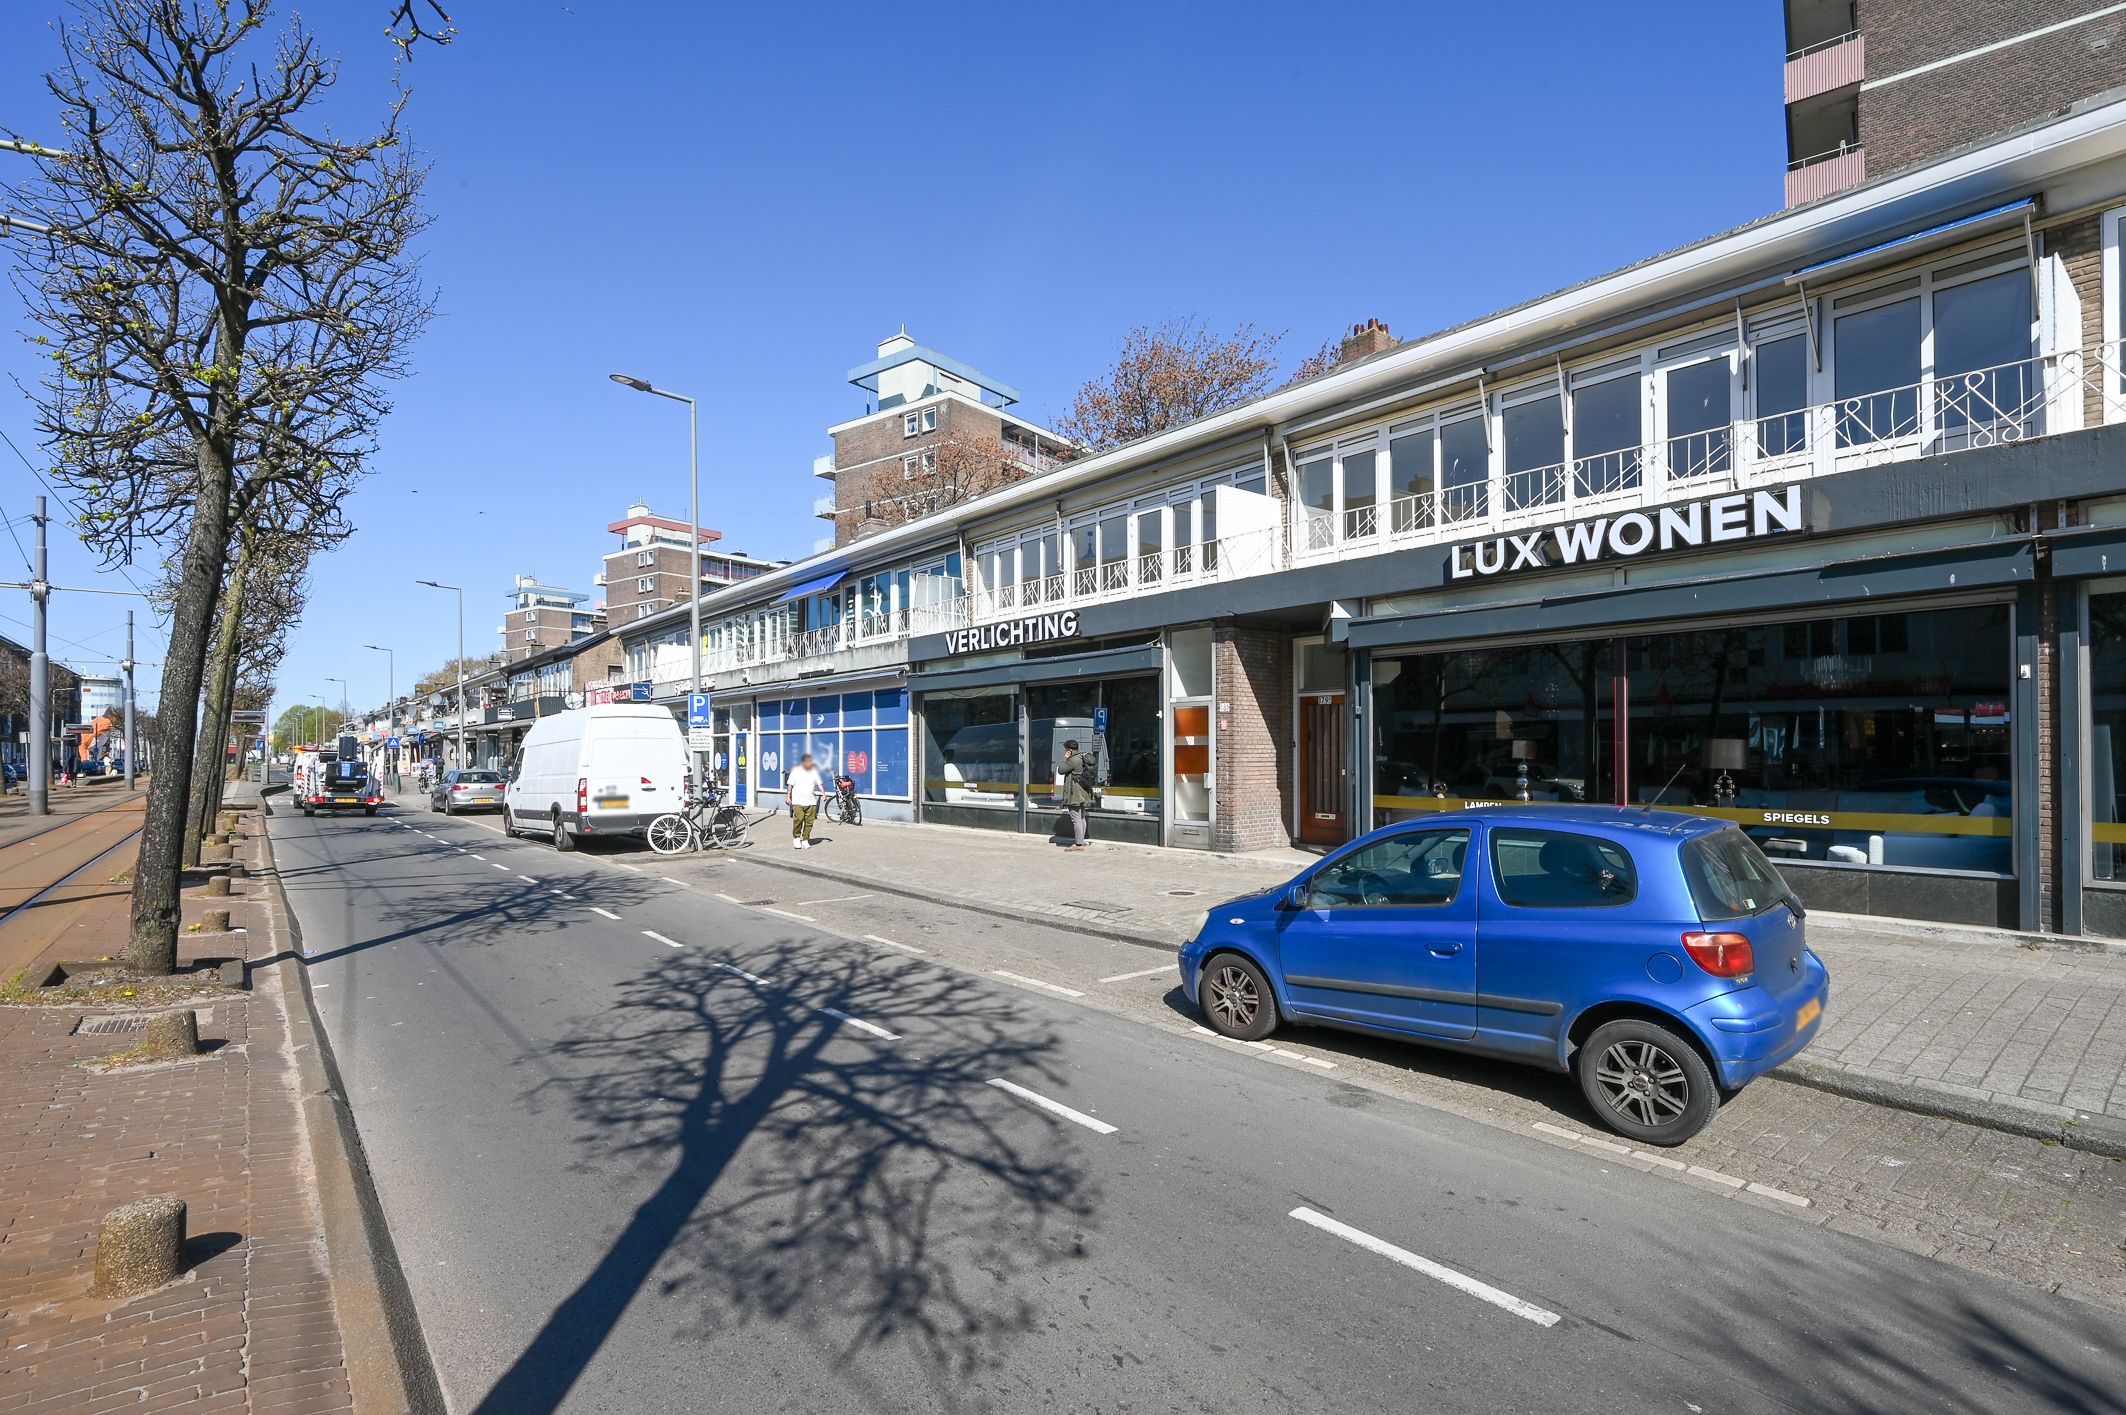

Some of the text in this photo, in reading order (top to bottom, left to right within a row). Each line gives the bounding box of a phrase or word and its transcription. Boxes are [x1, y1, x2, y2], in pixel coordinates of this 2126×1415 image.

[1451, 484, 1803, 579] LUX WONEN
[945, 610, 1078, 654] VERLICHTING
[693, 695, 706, 713] P
[1763, 812, 1830, 825] SPIEGELS
